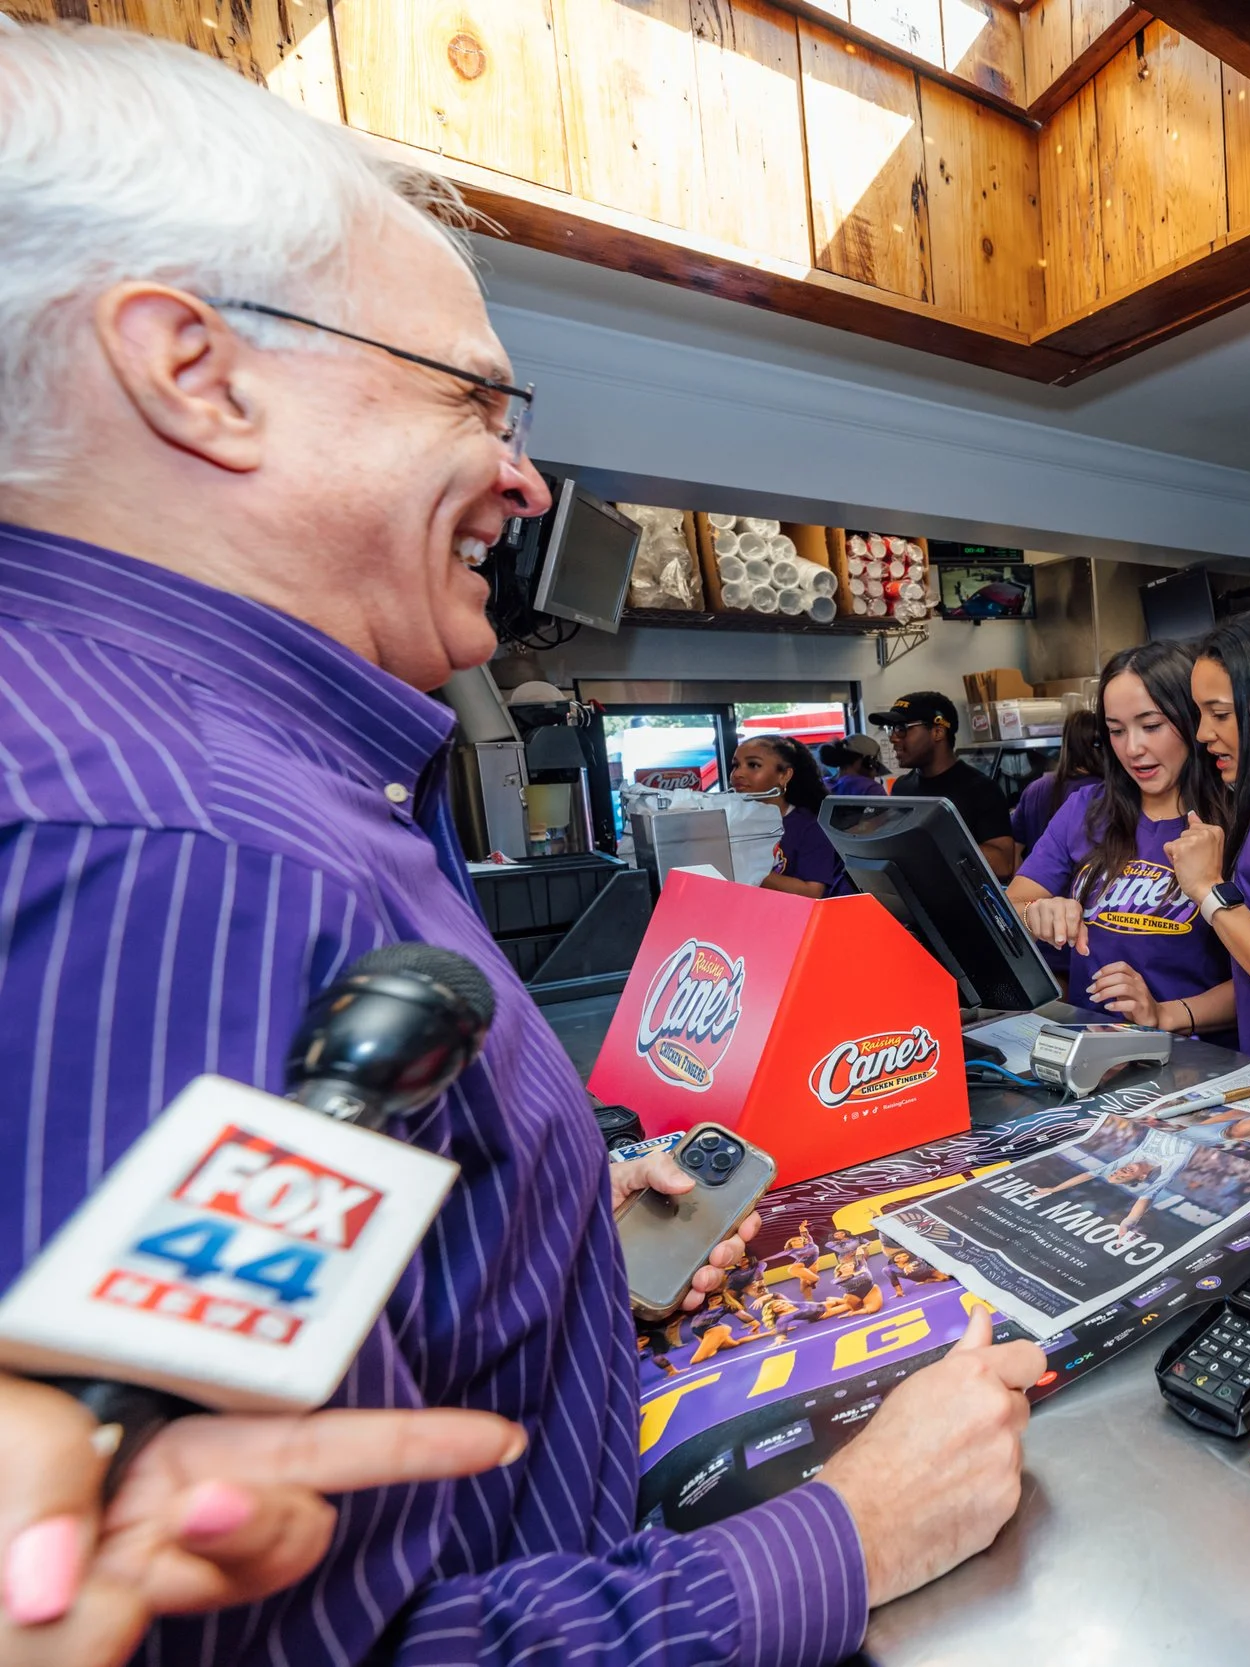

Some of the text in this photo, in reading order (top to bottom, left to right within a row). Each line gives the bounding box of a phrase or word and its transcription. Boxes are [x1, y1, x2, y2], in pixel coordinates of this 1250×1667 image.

[1107, 912, 1181, 931] CHICKEN FINGERS
[693, 951, 726, 984] Raising
[638, 939, 745, 1054] Cane's
[860, 1035, 902, 1055] Raising
[659, 1040, 708, 1084] CHICKEN FINGERS
[817, 1028, 938, 1108] Cane's
[861, 1070, 929, 1095] CHICKEN FINGERS
[882, 1096, 919, 1111] RaisingCanes
[185, 1142, 371, 1252] FOX
[1037, 1201, 1165, 1266] CROWN
[135, 1217, 328, 1309] 44
[1224, 1317, 1231, 1325] 1
[1212, 1328, 1220, 1336] 4
[1200, 1338, 1209, 1348] 7
[1235, 1338, 1244, 1348] 5
[1064, 1351, 1095, 1370] COX
[1222, 1350, 1232, 1359] 8
[1210, 1363, 1219, 1372] 0
